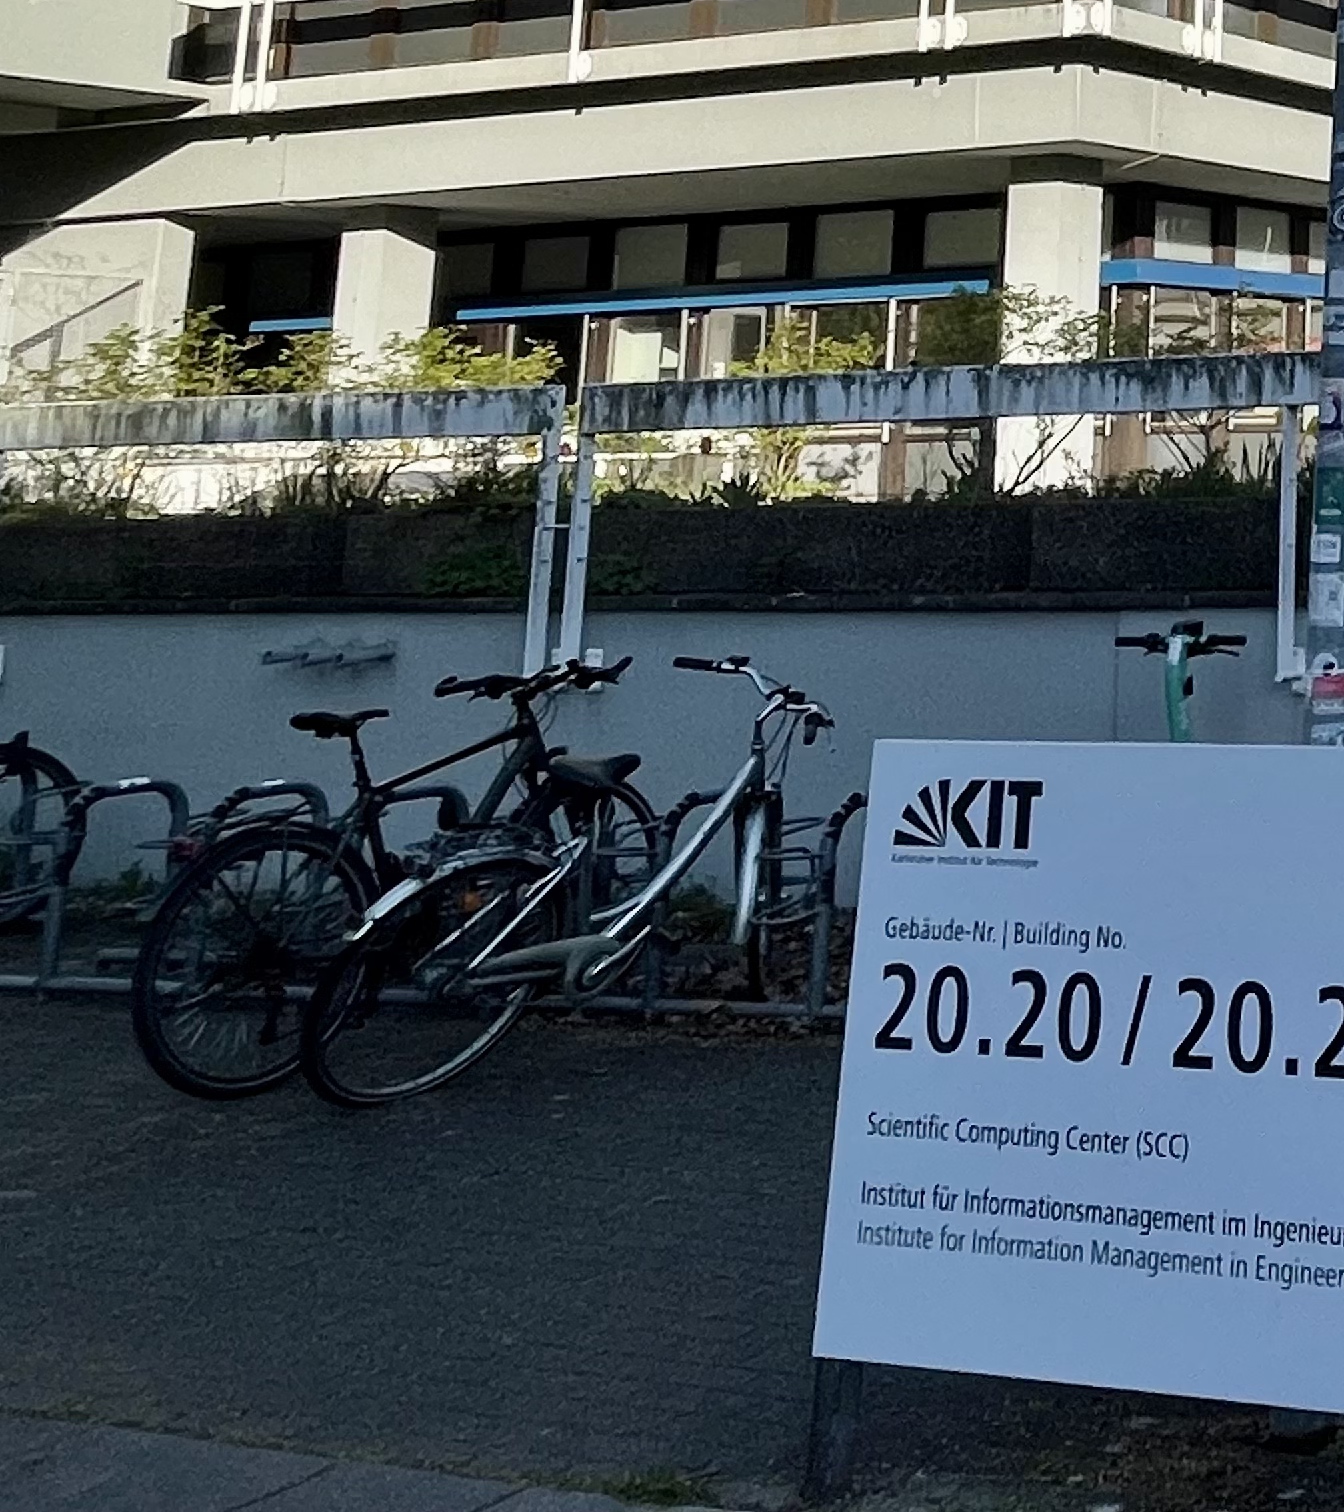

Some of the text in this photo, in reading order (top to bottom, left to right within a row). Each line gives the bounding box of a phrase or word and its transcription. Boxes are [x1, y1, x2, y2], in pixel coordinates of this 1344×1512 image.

[951, 779, 1044, 850] KIT
[885, 916, 996, 943] Gebäude-Nr.
[1013, 921, 1090, 953] Building
[1096, 925, 1127, 950] No.
[874, 963, 1101, 1062] 20.20
[1120, 975, 1153, 1066] /
[867, 1112, 1190, 1162] Scientific Computing Center (SCC)
[860, 1180, 926, 1210] Institut
[932, 1184, 959, 1212] für
[963, 1188, 1215, 1236] Informationsmanagement
[1221, 1208, 1247, 1238] im
[857, 1219, 934, 1250] Institute
[939, 1221, 966, 1252] for
[971, 1226, 1084, 1263] Information
[1090, 1239, 1223, 1278] Management
[1230, 1250, 1248, 1280] in
